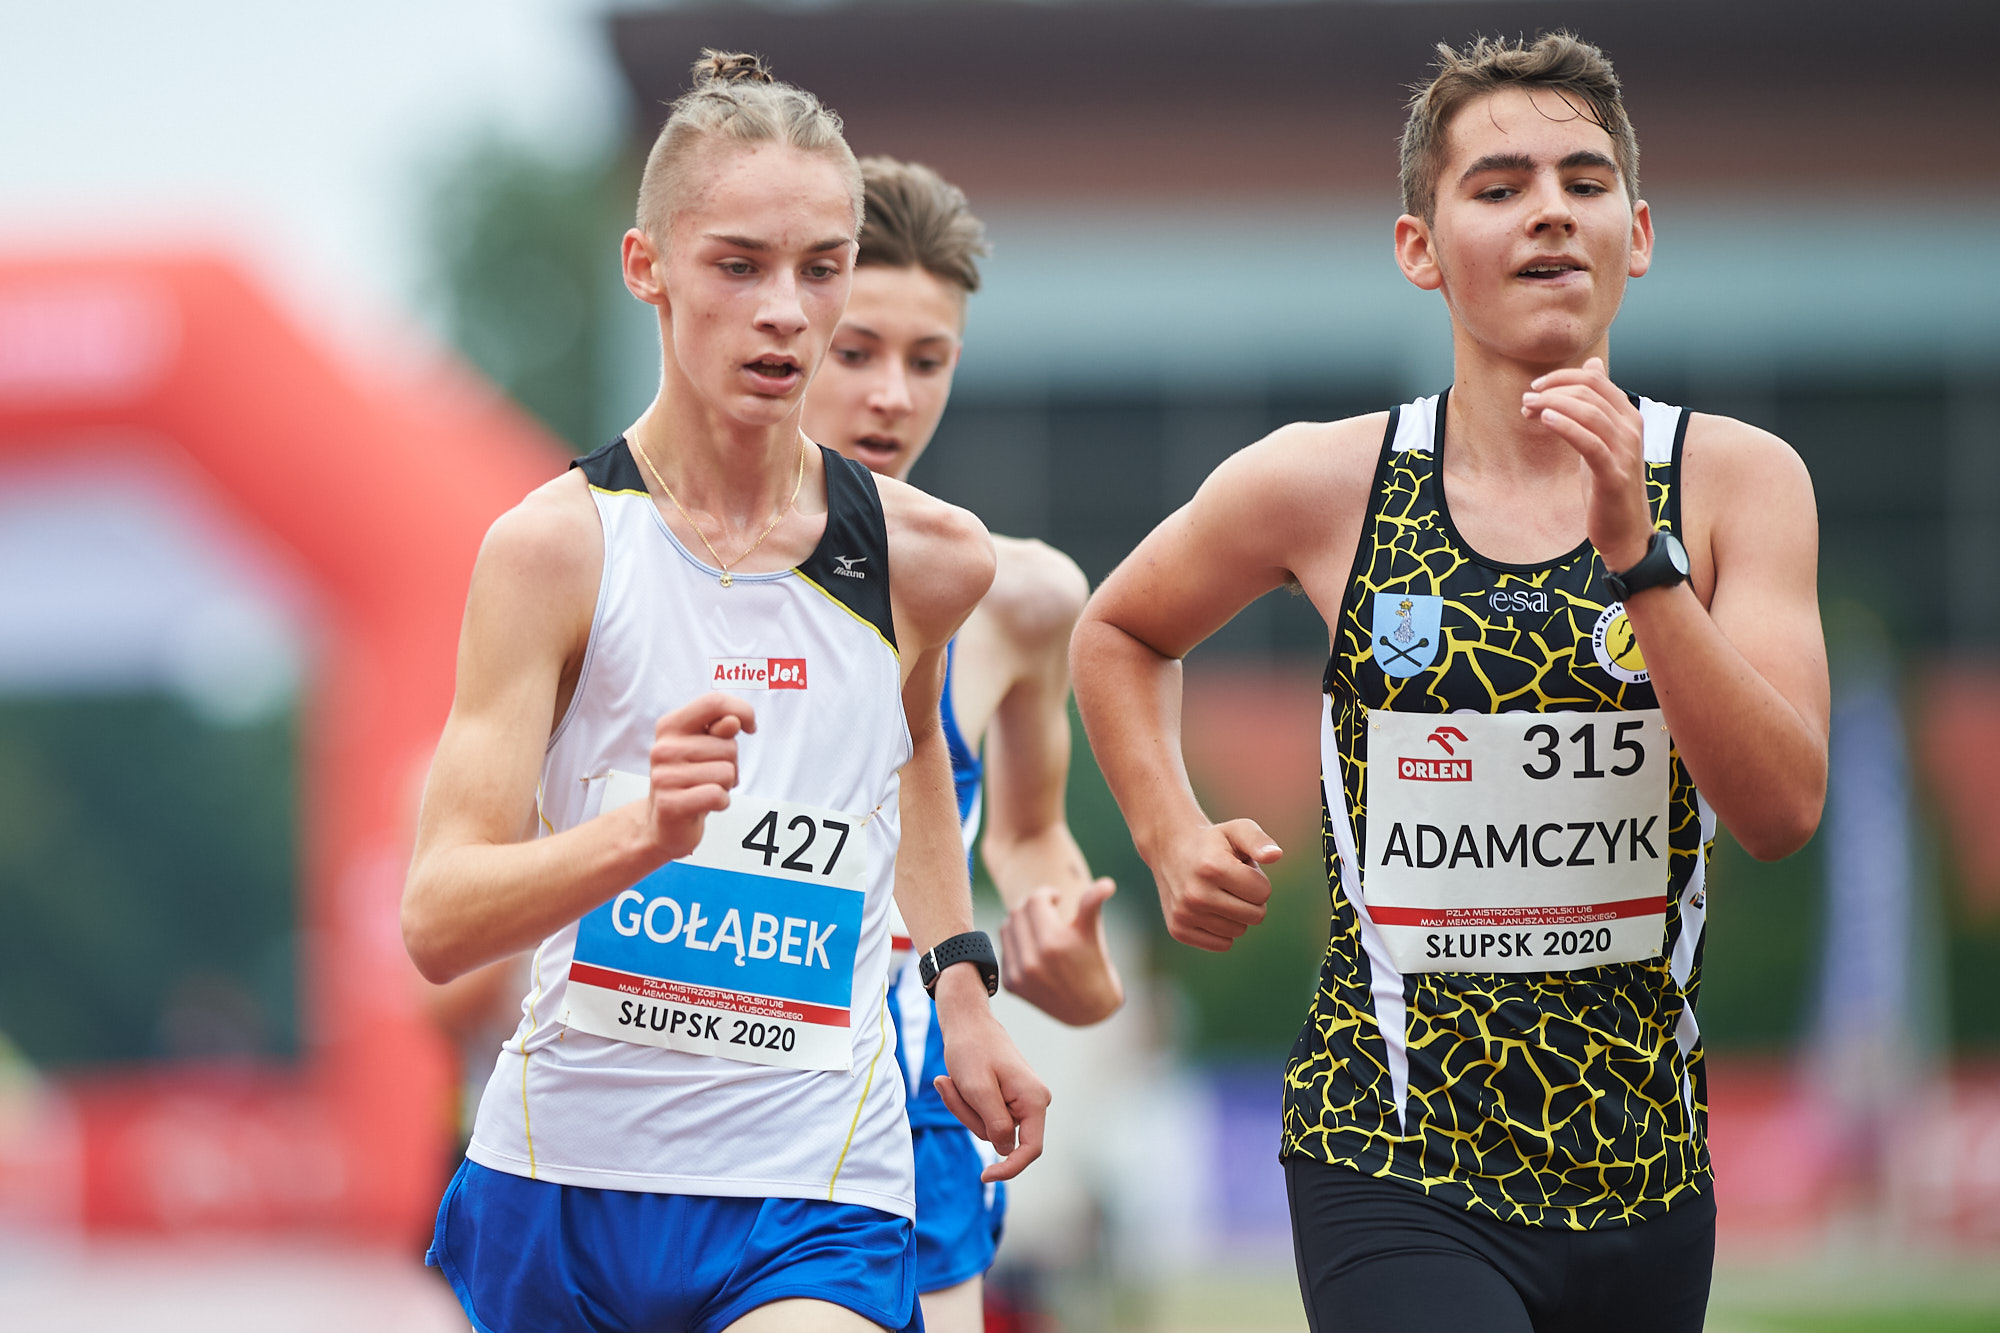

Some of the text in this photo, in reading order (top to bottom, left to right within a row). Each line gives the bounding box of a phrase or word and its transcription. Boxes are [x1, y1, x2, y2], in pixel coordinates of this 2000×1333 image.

[1594, 605, 1622, 648] UKS Herk
[1401, 760, 1467, 780] ORLEN
[1522, 720, 1645, 780] 315
[741, 810, 850, 875] 427
[1381, 815, 1659, 869] ADAMCZYK
[611, 889, 838, 970] GOŁĄBEK
[1420, 911, 1617, 926] MAŁY MEMORIAŁ JANUSZA KUSOCIŃSKIEGO
[1446, 905, 1592, 917] PZLA MISTRZOSTWA POLSKI U16
[1426, 927, 1612, 958] SŁUPSK 2020
[618, 983, 804, 1021] MAŁY MEMORIAŁ JANUSZA KUSOCIŃSKIEGO
[643, 979, 784, 1009] PZLA MISTRZOSTWA POLSKI U16
[618, 1000, 796, 1052] SŁUPSK 2020
